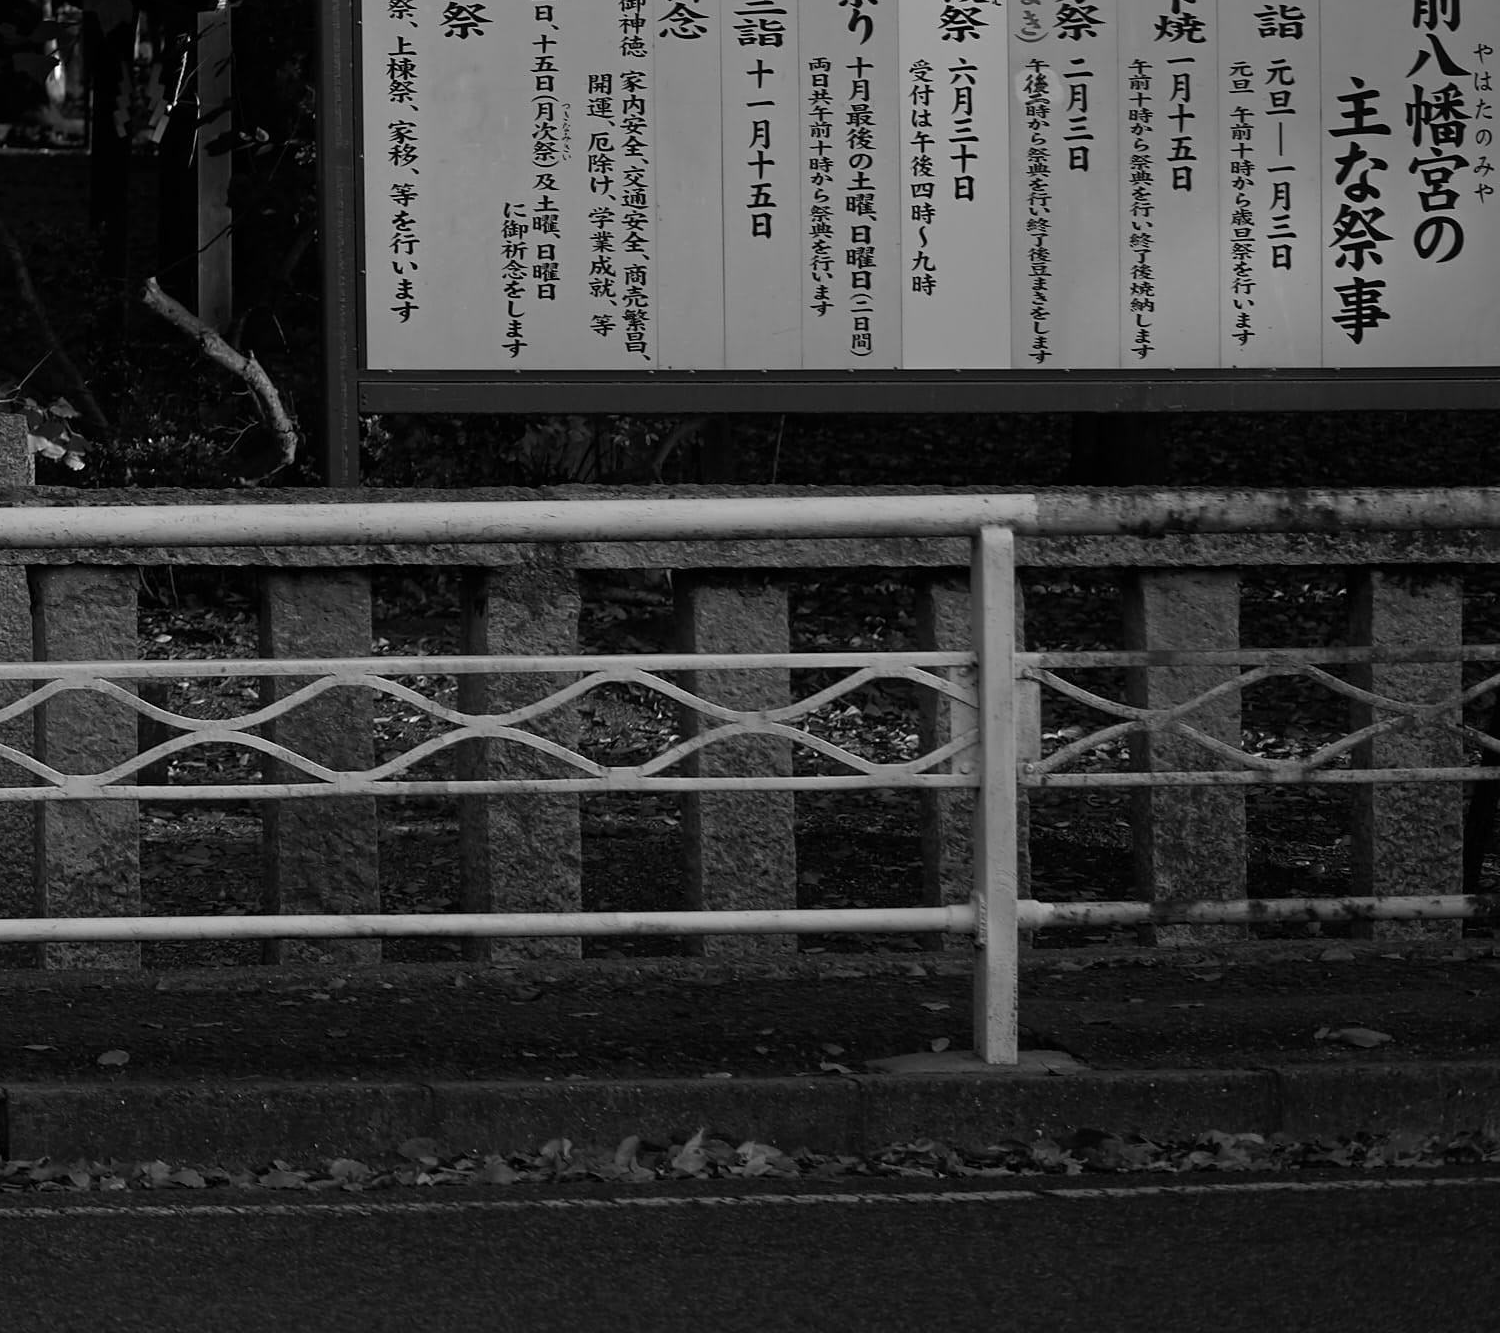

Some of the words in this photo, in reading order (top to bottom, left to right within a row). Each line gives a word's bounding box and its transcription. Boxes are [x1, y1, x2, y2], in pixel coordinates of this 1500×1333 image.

[746, 59, 777, 239] 十一月十五日
[808, 57, 835, 317] 両日共午前十時から祭典を行います
[948, 58, 979, 201] 六月三十日
[1063, 58, 1094, 172] 二月三日
[1166, 58, 1197, 192] 一月十五日
[1473, 43, 1494, 203] やはたのみや
[501, 202, 529, 358] に御祈念をします
[1128, 59, 1155, 359] 午前十時から祭典を行い終了後焼納します
[1328, 76, 1394, 345] 主な祭事
